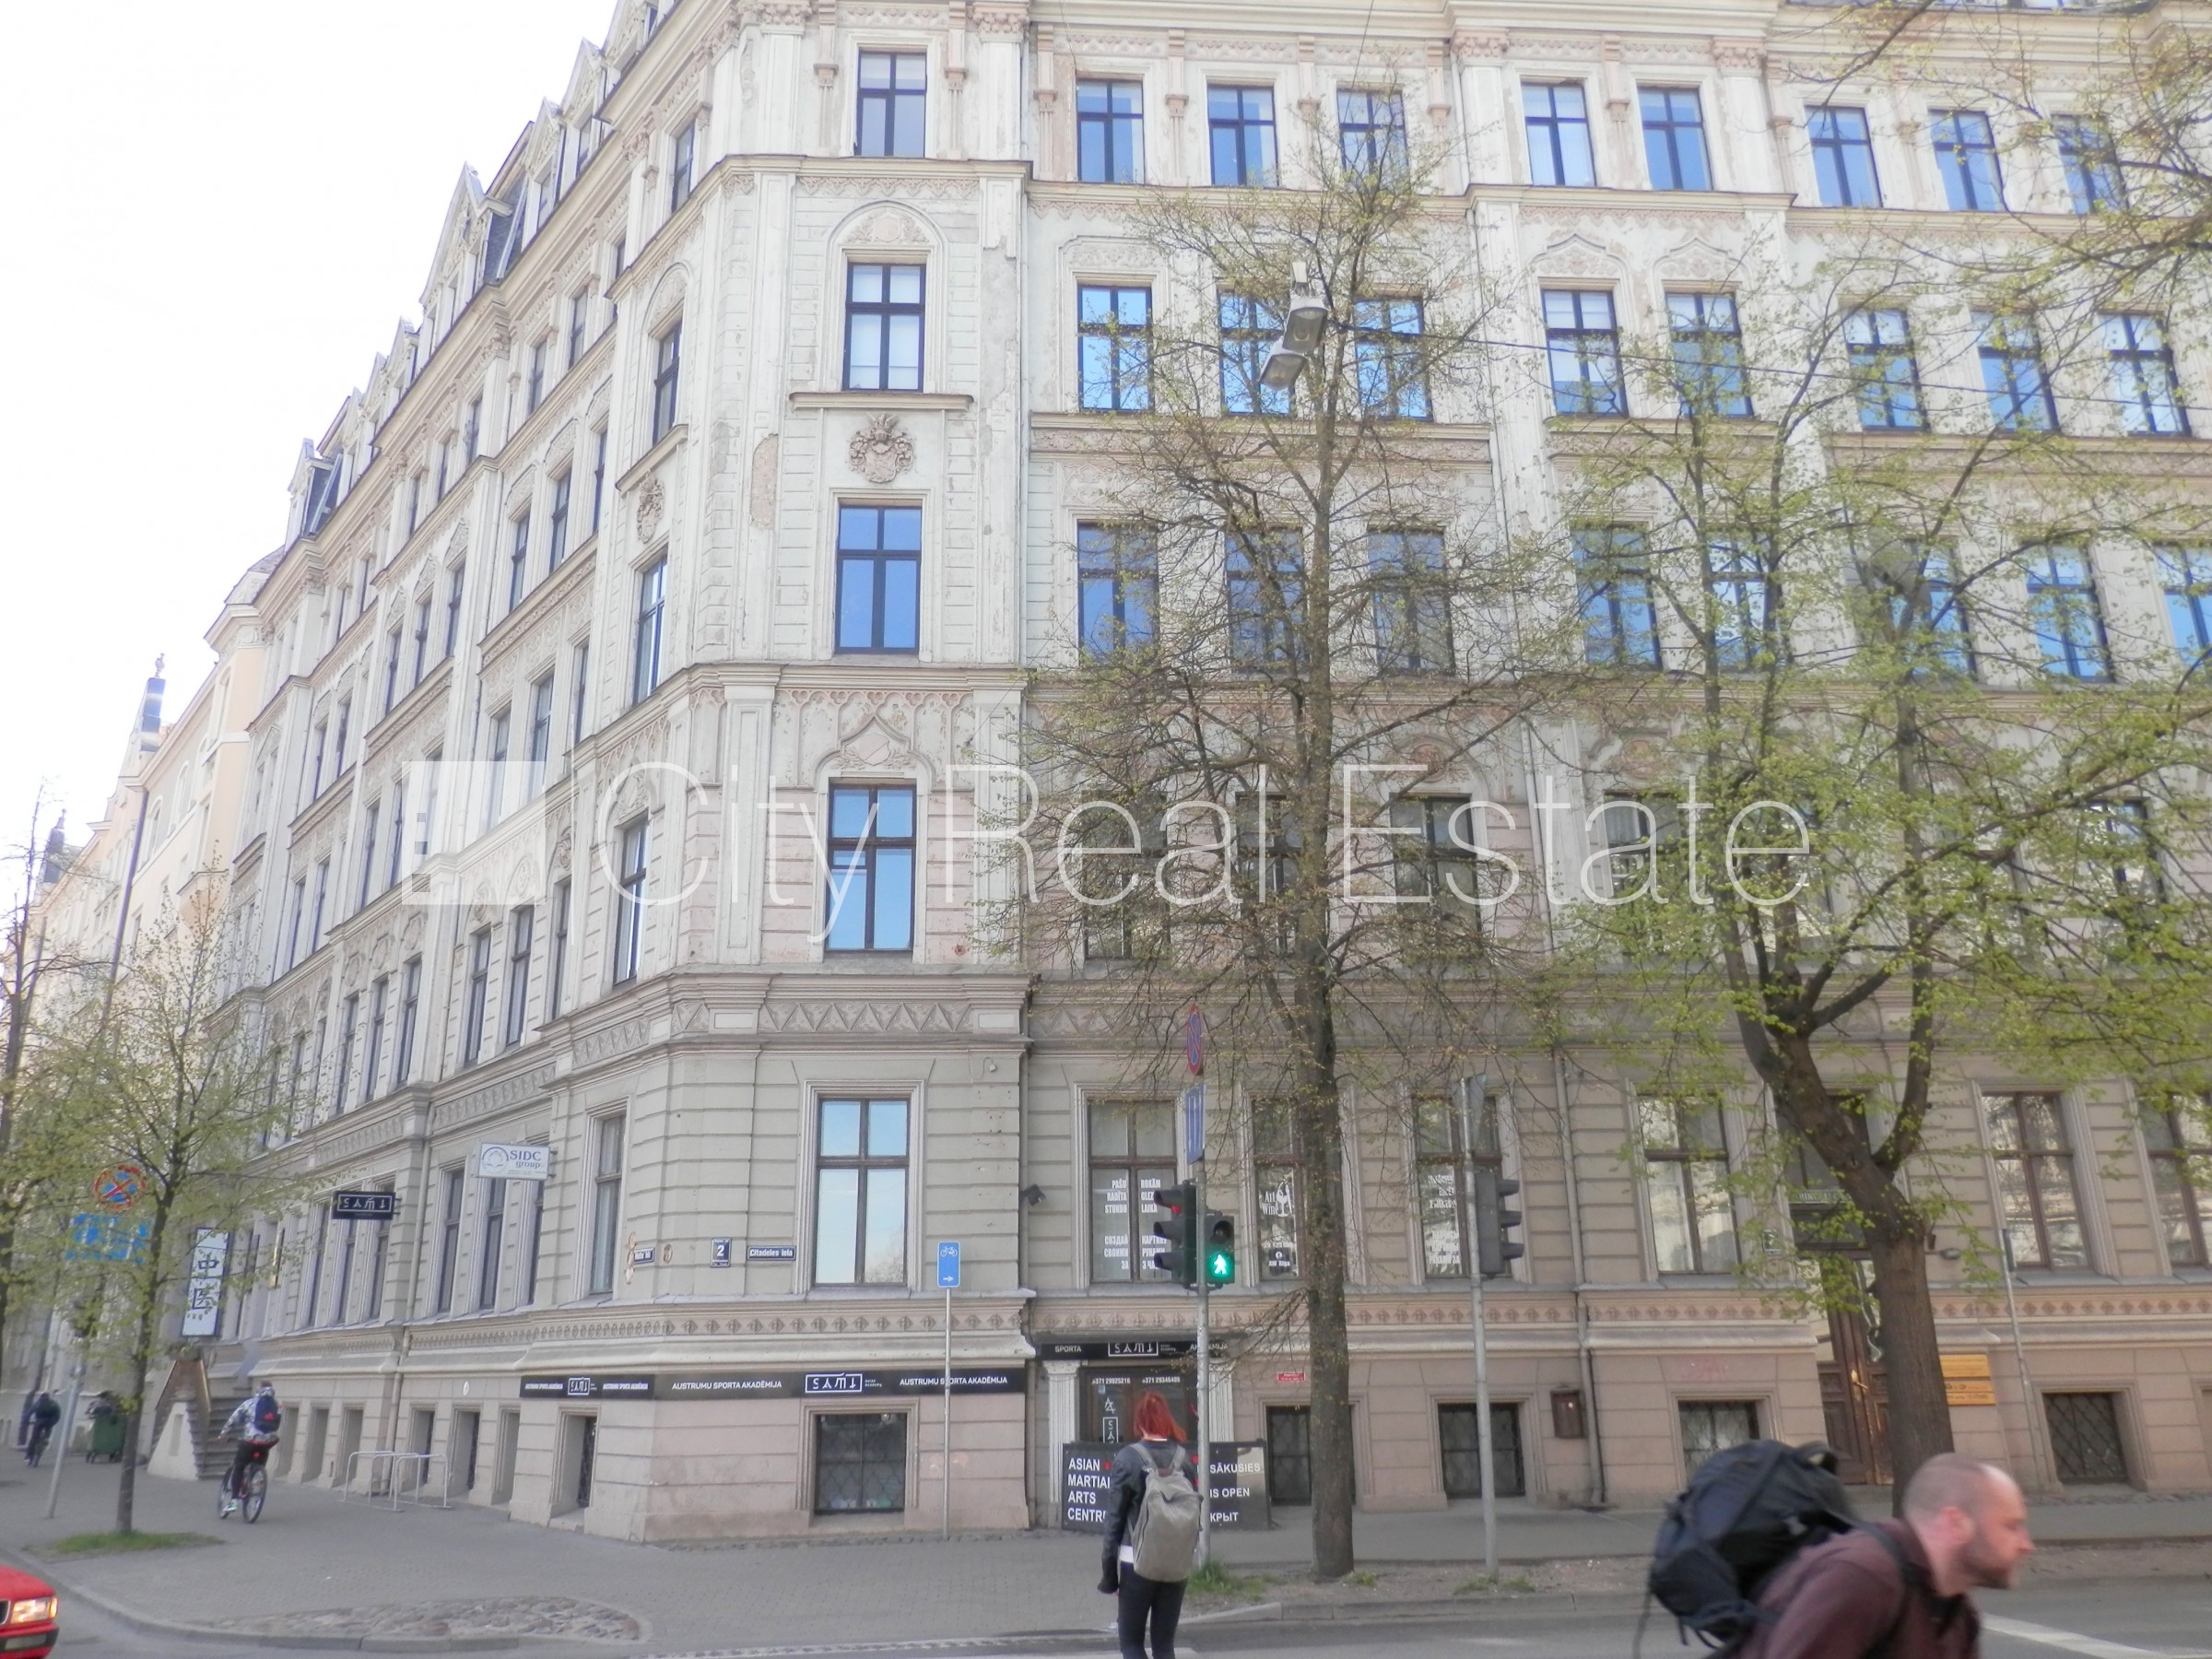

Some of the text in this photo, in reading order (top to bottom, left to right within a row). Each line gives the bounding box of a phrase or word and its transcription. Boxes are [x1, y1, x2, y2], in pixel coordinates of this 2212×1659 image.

[510, 1150, 541, 1161] SIDC
[716, 1244, 724, 1257] 2
[749, 1249, 780, 1257] Citadeles
[1054, 1345, 1082, 1353] SPORTA
[713, 1382, 741, 1390] SPORTA
[741, 1381, 782, 1389] AKADĒMIJA
[900, 1376, 1008, 1386] AUSTRUMU SORTA AKADĒMIJA
[1068, 1457, 1100, 1472] ASIAN
[1209, 1462, 1261, 1475] SĀKUSIES
[1067, 1490, 1097, 1505] ARTS
[1209, 1487, 1250, 1499] IS OPEN
[1209, 1512, 1239, 1523] КРЫТ
